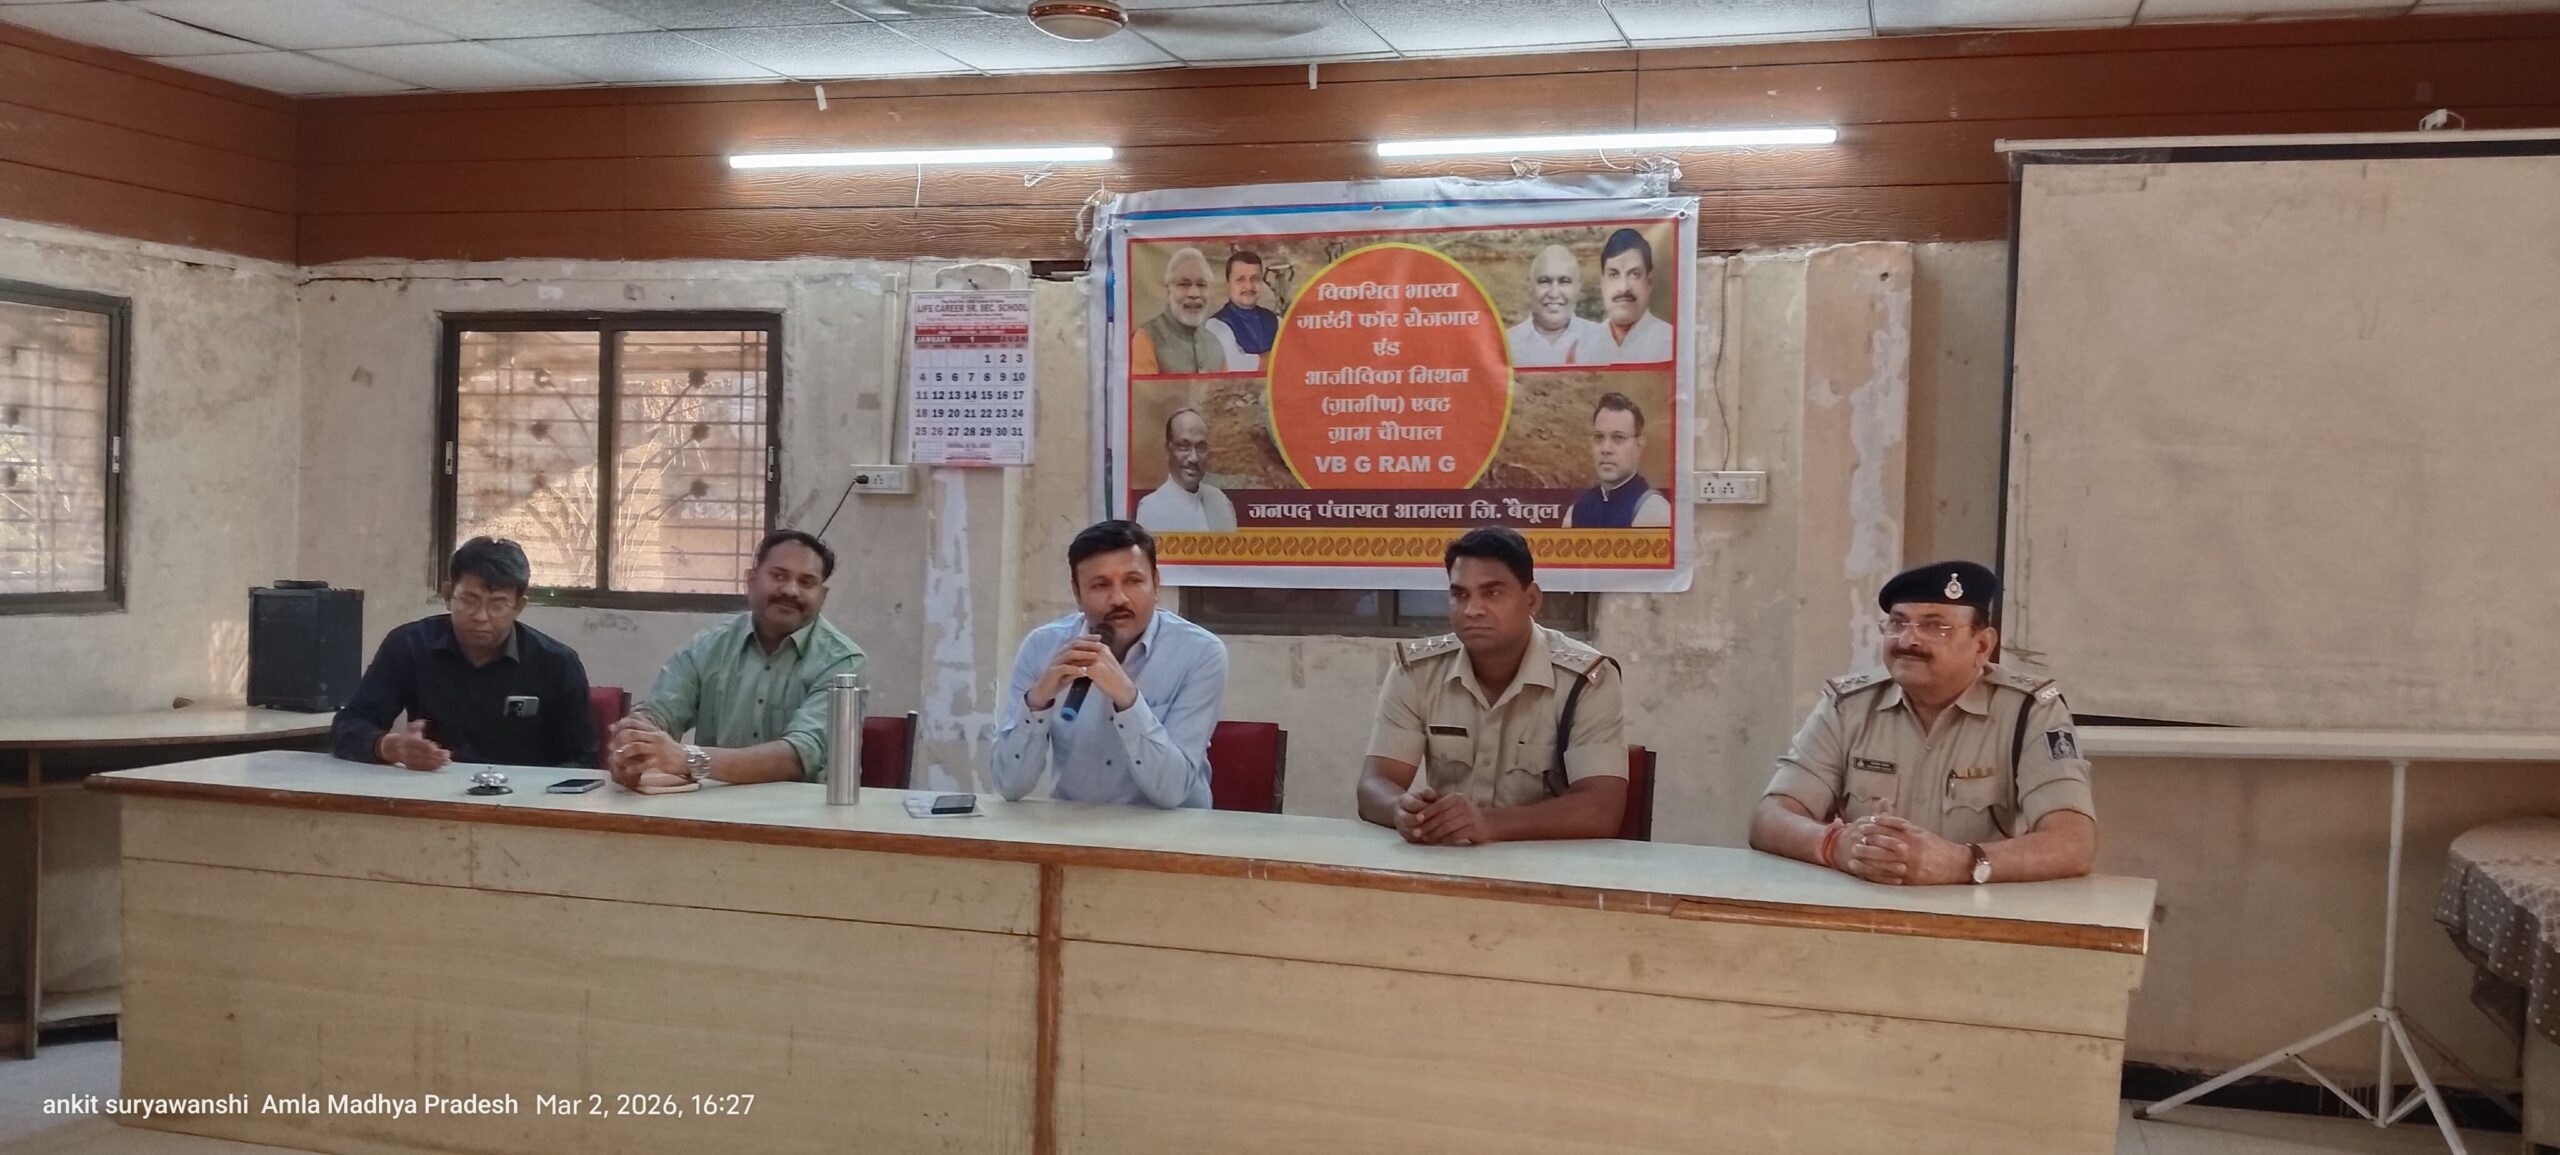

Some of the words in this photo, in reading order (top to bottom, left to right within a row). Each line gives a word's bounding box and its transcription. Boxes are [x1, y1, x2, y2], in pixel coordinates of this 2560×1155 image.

[1318, 282, 1400, 300] विकसित
[1406, 283, 1459, 298] भारत
[935, 304, 964, 312] CAREER
[998, 304, 1029, 312] SCHOOL
[1297, 311, 1354, 329] गारंटी
[1359, 311, 1398, 327] फॉर
[1405, 307, 1480, 327] रोजगार
[1373, 338, 1400, 356] एंड
[985, 355, 991, 363] 1
[1000, 355, 1007, 363] 2
[1016, 355, 1023, 363] 3
[920, 373, 926, 381] 4
[936, 373, 942, 381] 5
[952, 373, 958, 381] 6
[968, 373, 974, 381] 7
[984, 373, 990, 381] 8
[1000, 373, 1006, 381] 9
[1013, 373, 1025, 381] 10
[1305, 367, 1401, 385] आजीविका
[1409, 365, 1470, 384] मिशन
[916, 391, 928, 400] 11
[932, 391, 945, 400] 12
[949, 391, 961, 400] 13
[965, 391, 977, 400] 14
[981, 391, 992, 400] 15
[997, 391, 1008, 400] 16
[1013, 391, 1024, 400] 17
[1322, 395, 1405, 415] (ग्रामीण)
[1411, 397, 1451, 412] एक्ट
[916, 410, 928, 418] 18
[933, 410, 944, 418] 19
[948, 410, 960, 418] 20
[964, 410, 976, 418] 21
[980, 410, 992, 418] 22
[996, 410, 1007, 418] 23
[1012, 410, 1023, 418] 24
[915, 428, 927, 436] 25
[932, 428, 943, 436] 26
[948, 428, 959, 436] 27
[964, 428, 976, 436] 28
[980, 428, 991, 436] 29
[996, 428, 1007, 436] 30
[1011, 428, 1023, 436] 31
[1328, 426, 1371, 443] ग्राम
[1315, 456, 1347, 472] VB
[1355, 456, 1371, 472] G
[1379, 456, 1430, 472] RAM
[1439, 456, 1455, 472] G
[1248, 504, 1312, 520] जनपद
[1316, 499, 1390, 518] पंचायत
[1394, 504, 1465, 518] आमला
[1503, 498, 1561, 523] बैतूल
